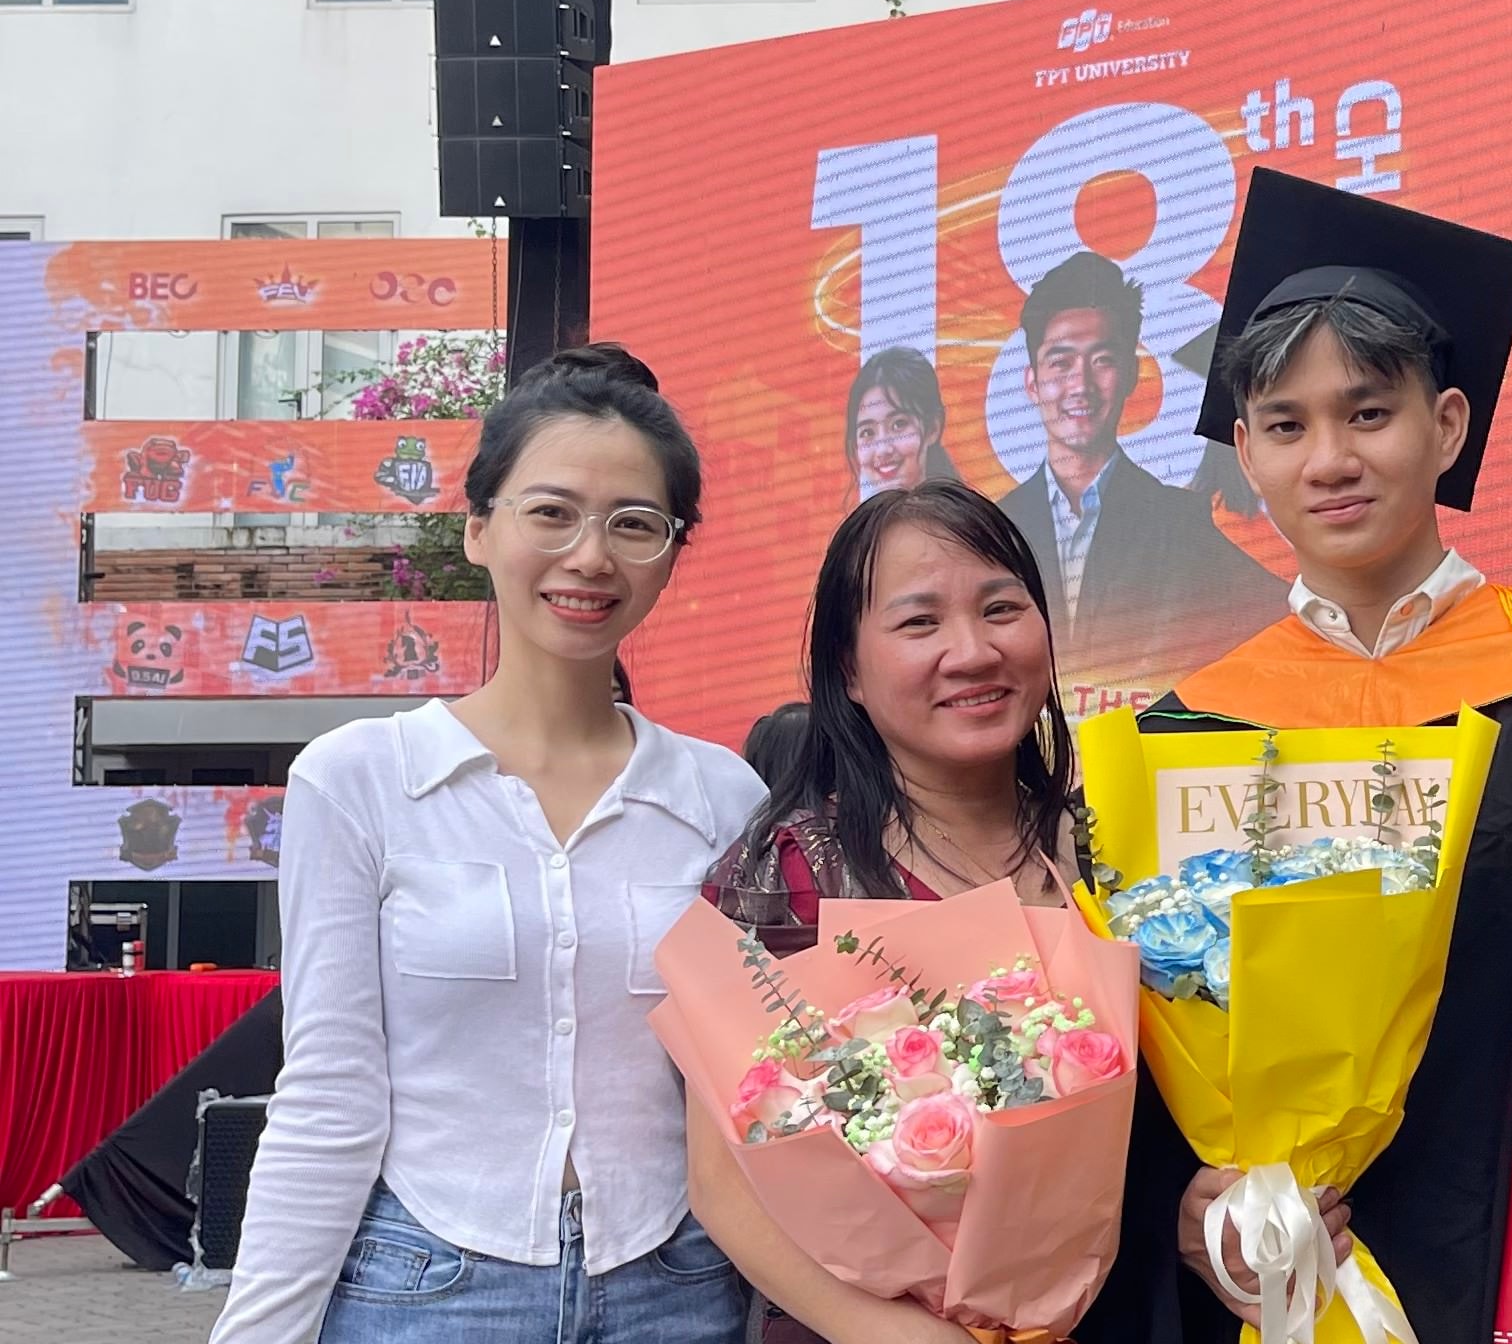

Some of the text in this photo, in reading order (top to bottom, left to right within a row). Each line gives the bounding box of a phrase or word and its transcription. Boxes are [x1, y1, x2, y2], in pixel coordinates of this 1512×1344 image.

[1057, 9, 1112, 52] FPT
[1035, 50, 1191, 87] FPT UNIVERSITY
[128, 272, 197, 300] BEC
[1073, 685, 1151, 716] THE
